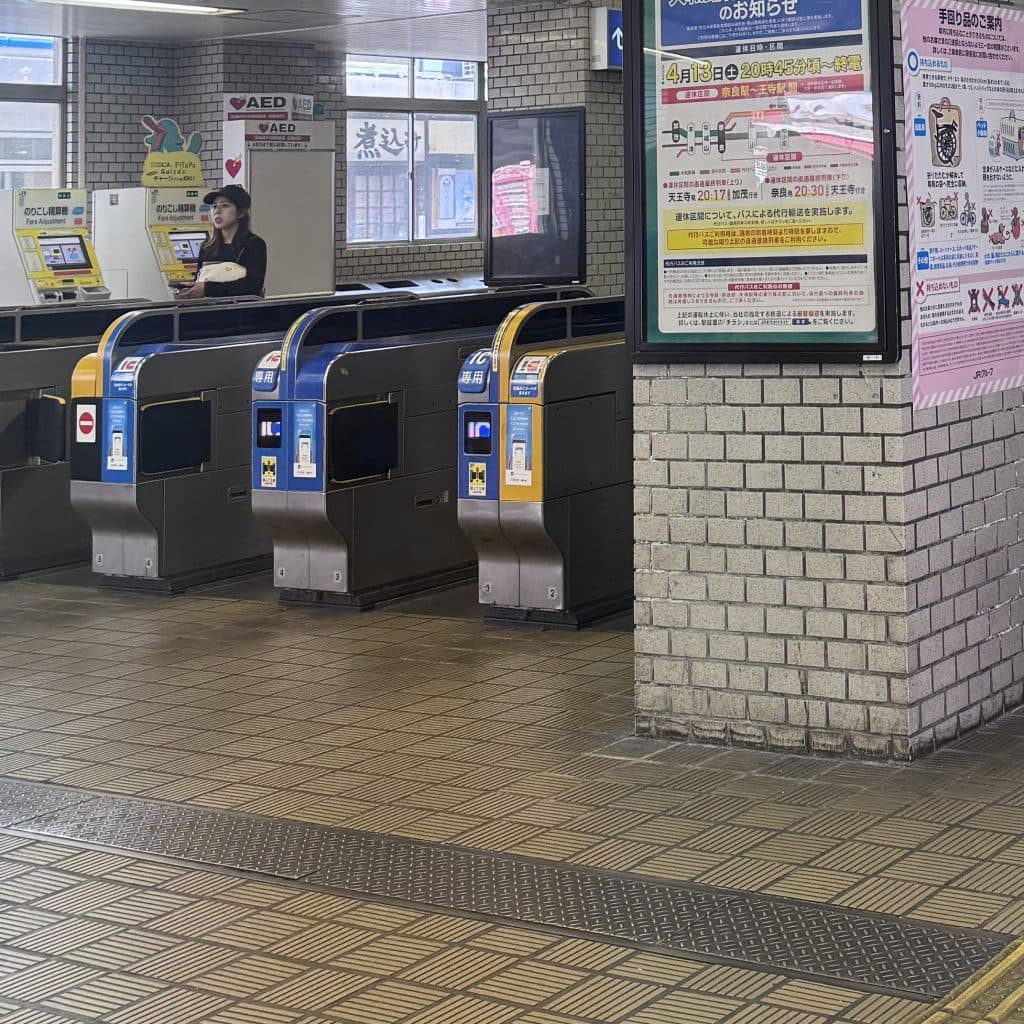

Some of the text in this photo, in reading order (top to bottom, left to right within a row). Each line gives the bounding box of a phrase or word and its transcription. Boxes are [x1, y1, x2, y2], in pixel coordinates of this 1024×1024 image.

[939, 8, 1002, 32] 手回り品のご案内
[246, 96, 287, 108] AED
[299, 98, 312, 110] AED
[270, 123, 296, 133] AED
[697, 189, 726, 202] 20:17
[795, 184, 824, 197] 20:30
[470, 351, 491, 365] IC
[255, 370, 273, 384] 専用
[462, 370, 484, 384] 専用
